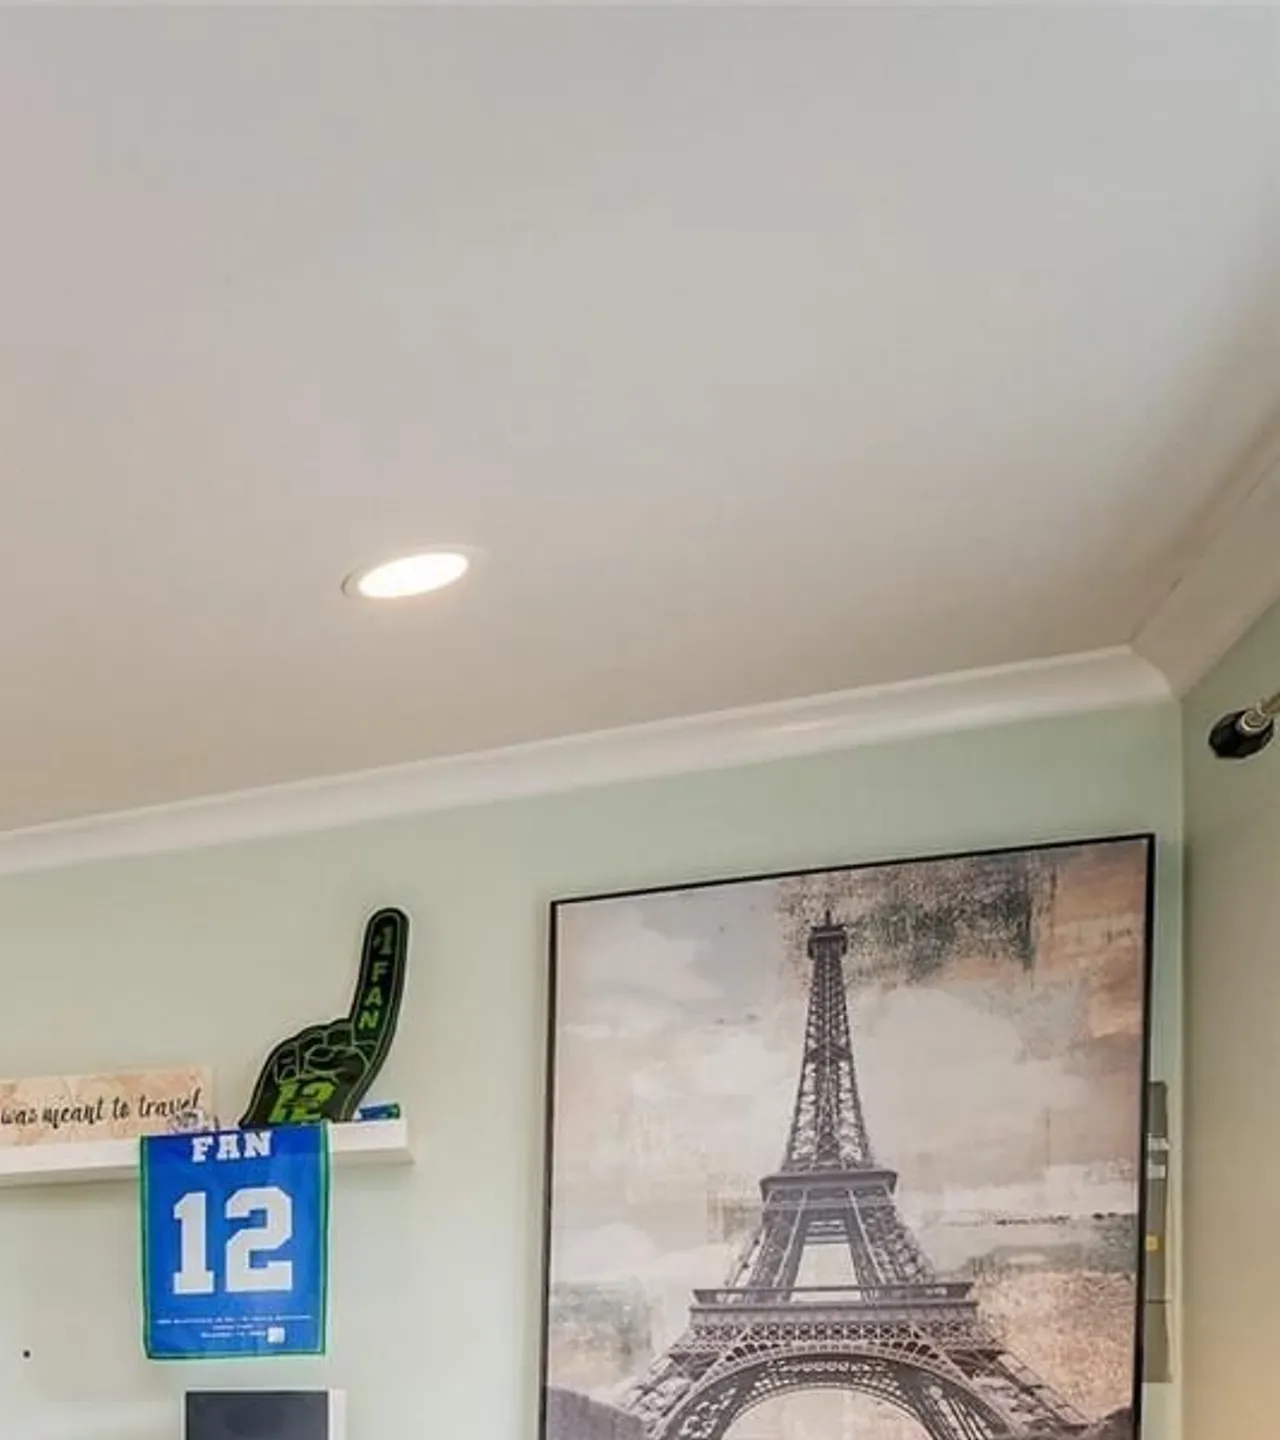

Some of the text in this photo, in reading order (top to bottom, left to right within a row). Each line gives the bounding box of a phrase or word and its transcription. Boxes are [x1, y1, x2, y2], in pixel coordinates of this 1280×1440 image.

[0, 1107, 38, 1126] was
[42, 1096, 104, 1129] meant
[112, 1096, 130, 1120] to
[139, 1087, 201, 1117] travel
[268, 1078, 336, 1122] 12
[192, 1131, 272, 1163] FAN
[173, 1186, 293, 1294] 12
